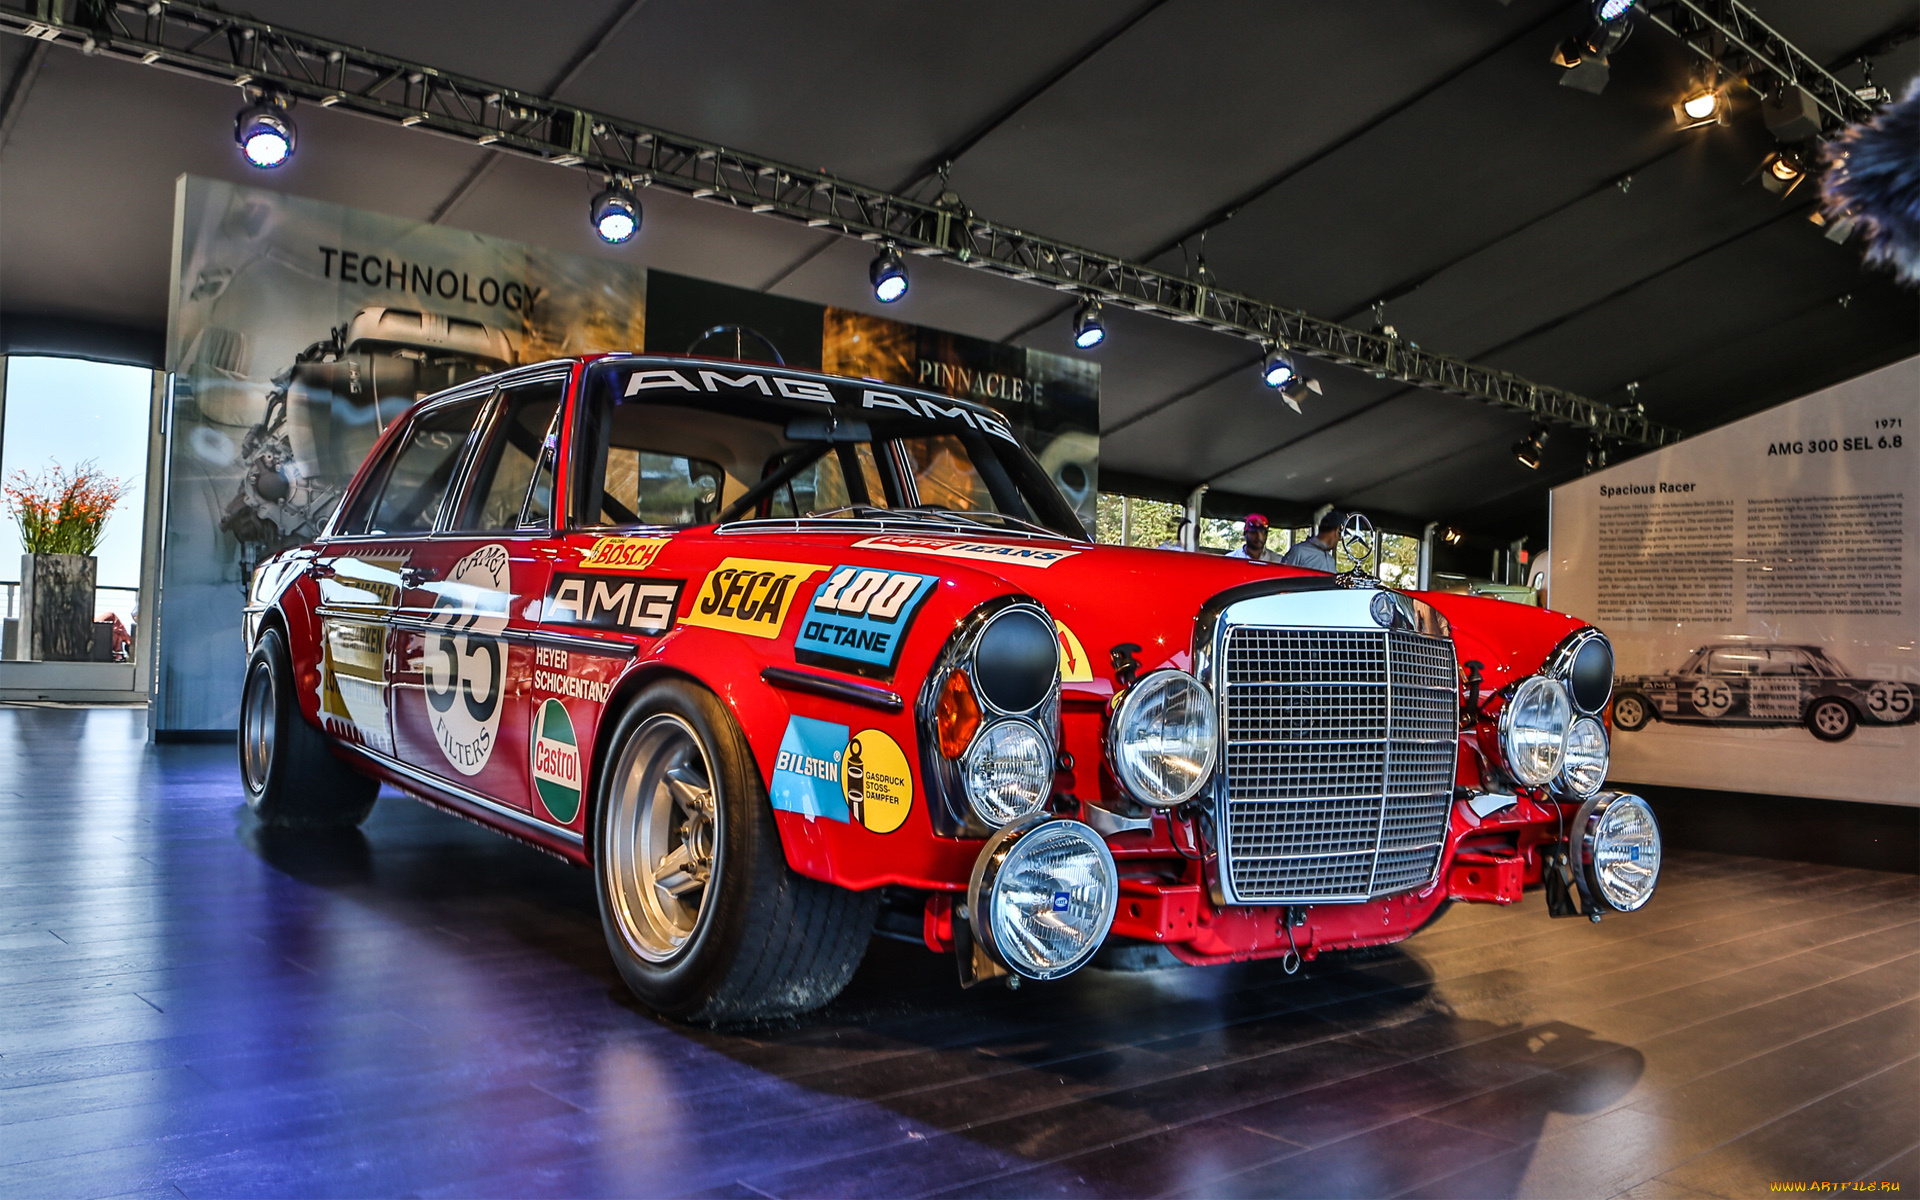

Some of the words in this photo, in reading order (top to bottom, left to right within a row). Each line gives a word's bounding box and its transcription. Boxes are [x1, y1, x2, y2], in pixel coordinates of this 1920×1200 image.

[318, 245, 541, 313] TECHNOLOGY
[919, 359, 1023, 402] PINNACLE
[624, 370, 836, 404] AMG
[863, 389, 1021, 449] AMG
[1875, 418, 1902, 429] 1971
[1768, 442, 1803, 456] AMG
[1808, 440, 1839, 454] 300
[1843, 437, 1874, 451] SEL
[1878, 435, 1903, 449] 6.8
[1600, 482, 1656, 498] Spacious
[1659, 482, 1697, 493] Racer
[456, 547, 506, 588] CAMEL
[592, 543, 660, 566] BOSCH
[952, 543, 1064, 560] JEANS
[547, 579, 678, 630] AMG
[700, 568, 796, 624] SECA
[814, 568, 923, 621] 100
[803, 621, 891, 653] OCTANE
[425, 589, 501, 722] 35
[536, 647, 568, 670] HEYER
[534, 670, 610, 703] SCHICKENTANZ
[1642, 681, 1677, 690] AMG
[1694, 686, 1729, 708] 35
[1869, 688, 1910, 713] 35
[437, 716, 490, 767] FILTERS
[536, 740, 577, 781] Castrol
[865, 772, 905, 787] GASDRUCK
[865, 782, 891, 793] STOSS-
